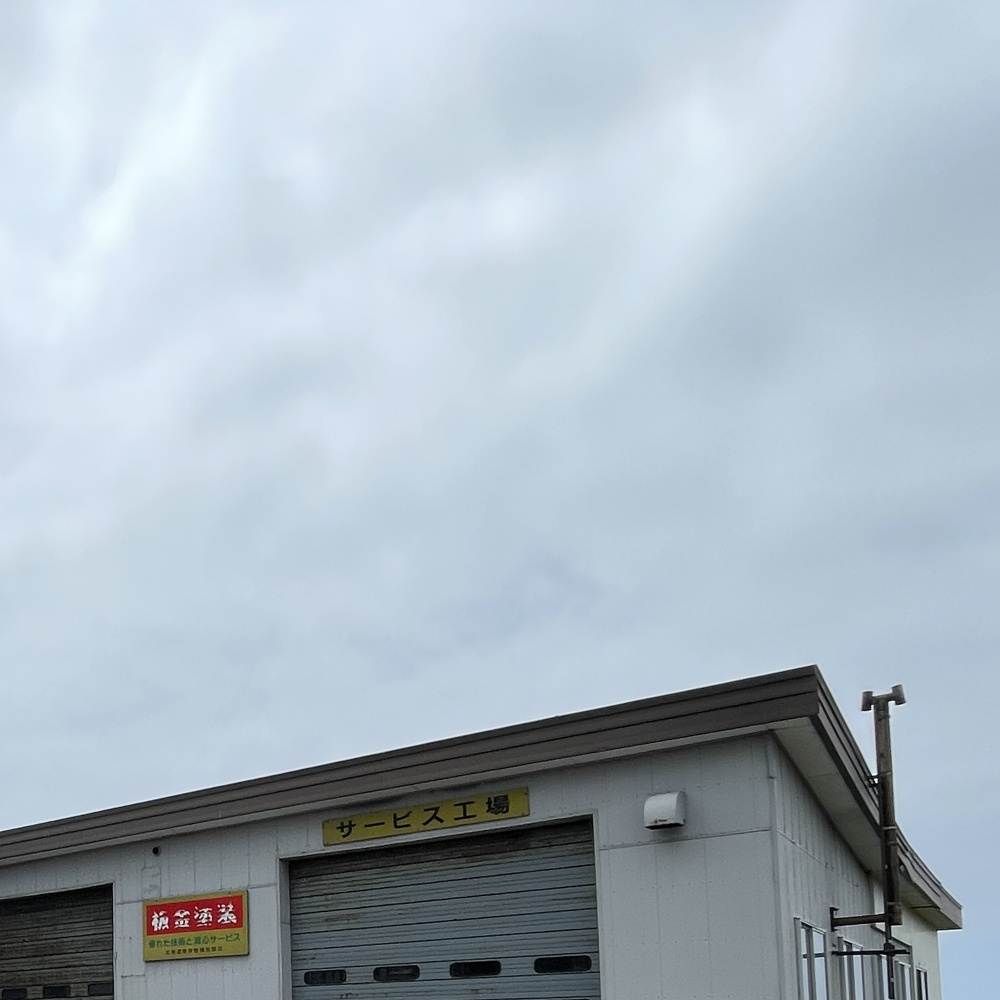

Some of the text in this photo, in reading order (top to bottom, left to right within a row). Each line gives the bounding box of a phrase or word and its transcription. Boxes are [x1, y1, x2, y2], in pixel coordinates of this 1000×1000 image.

[336, 794, 510, 838] サービス工場
[151, 901, 237, 931] 板金塗装
